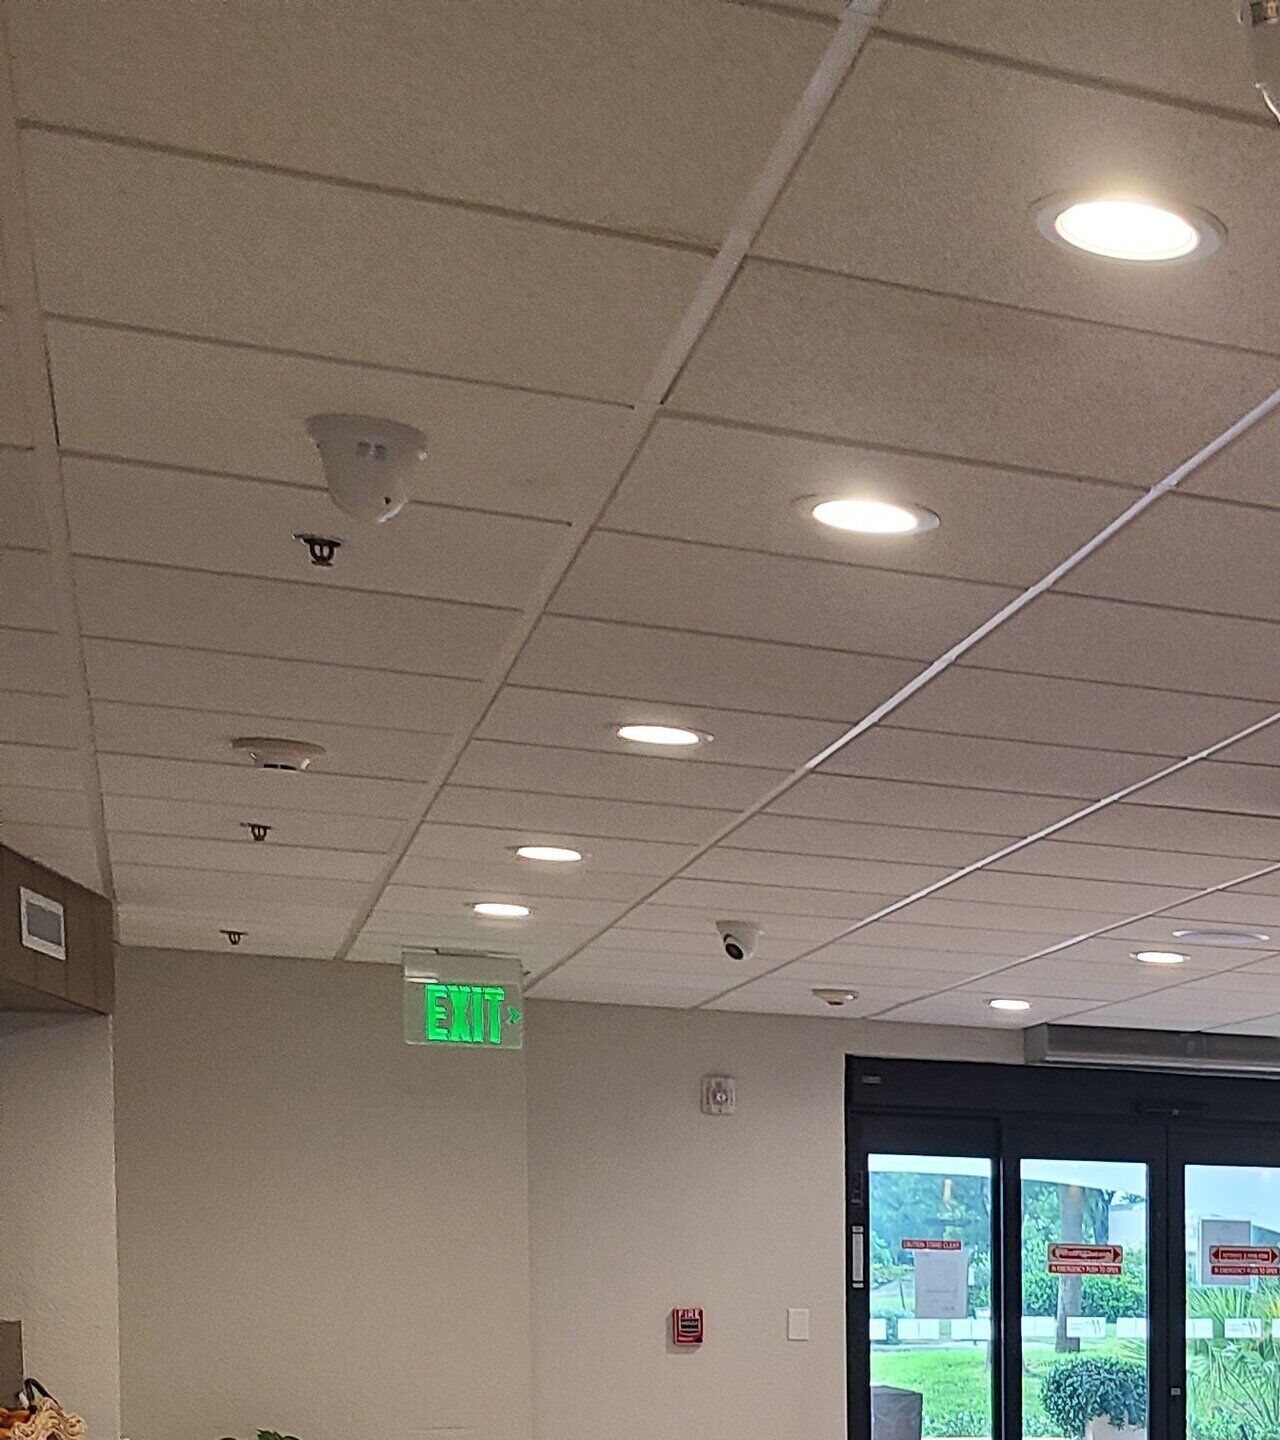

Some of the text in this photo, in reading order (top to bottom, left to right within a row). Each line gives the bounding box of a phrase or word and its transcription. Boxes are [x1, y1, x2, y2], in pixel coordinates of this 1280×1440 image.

[426, 984, 505, 1044] EXIT
[1057, 1265, 1085, 1273] EMERGENCY
[679, 1308, 700, 1318] FIRE
